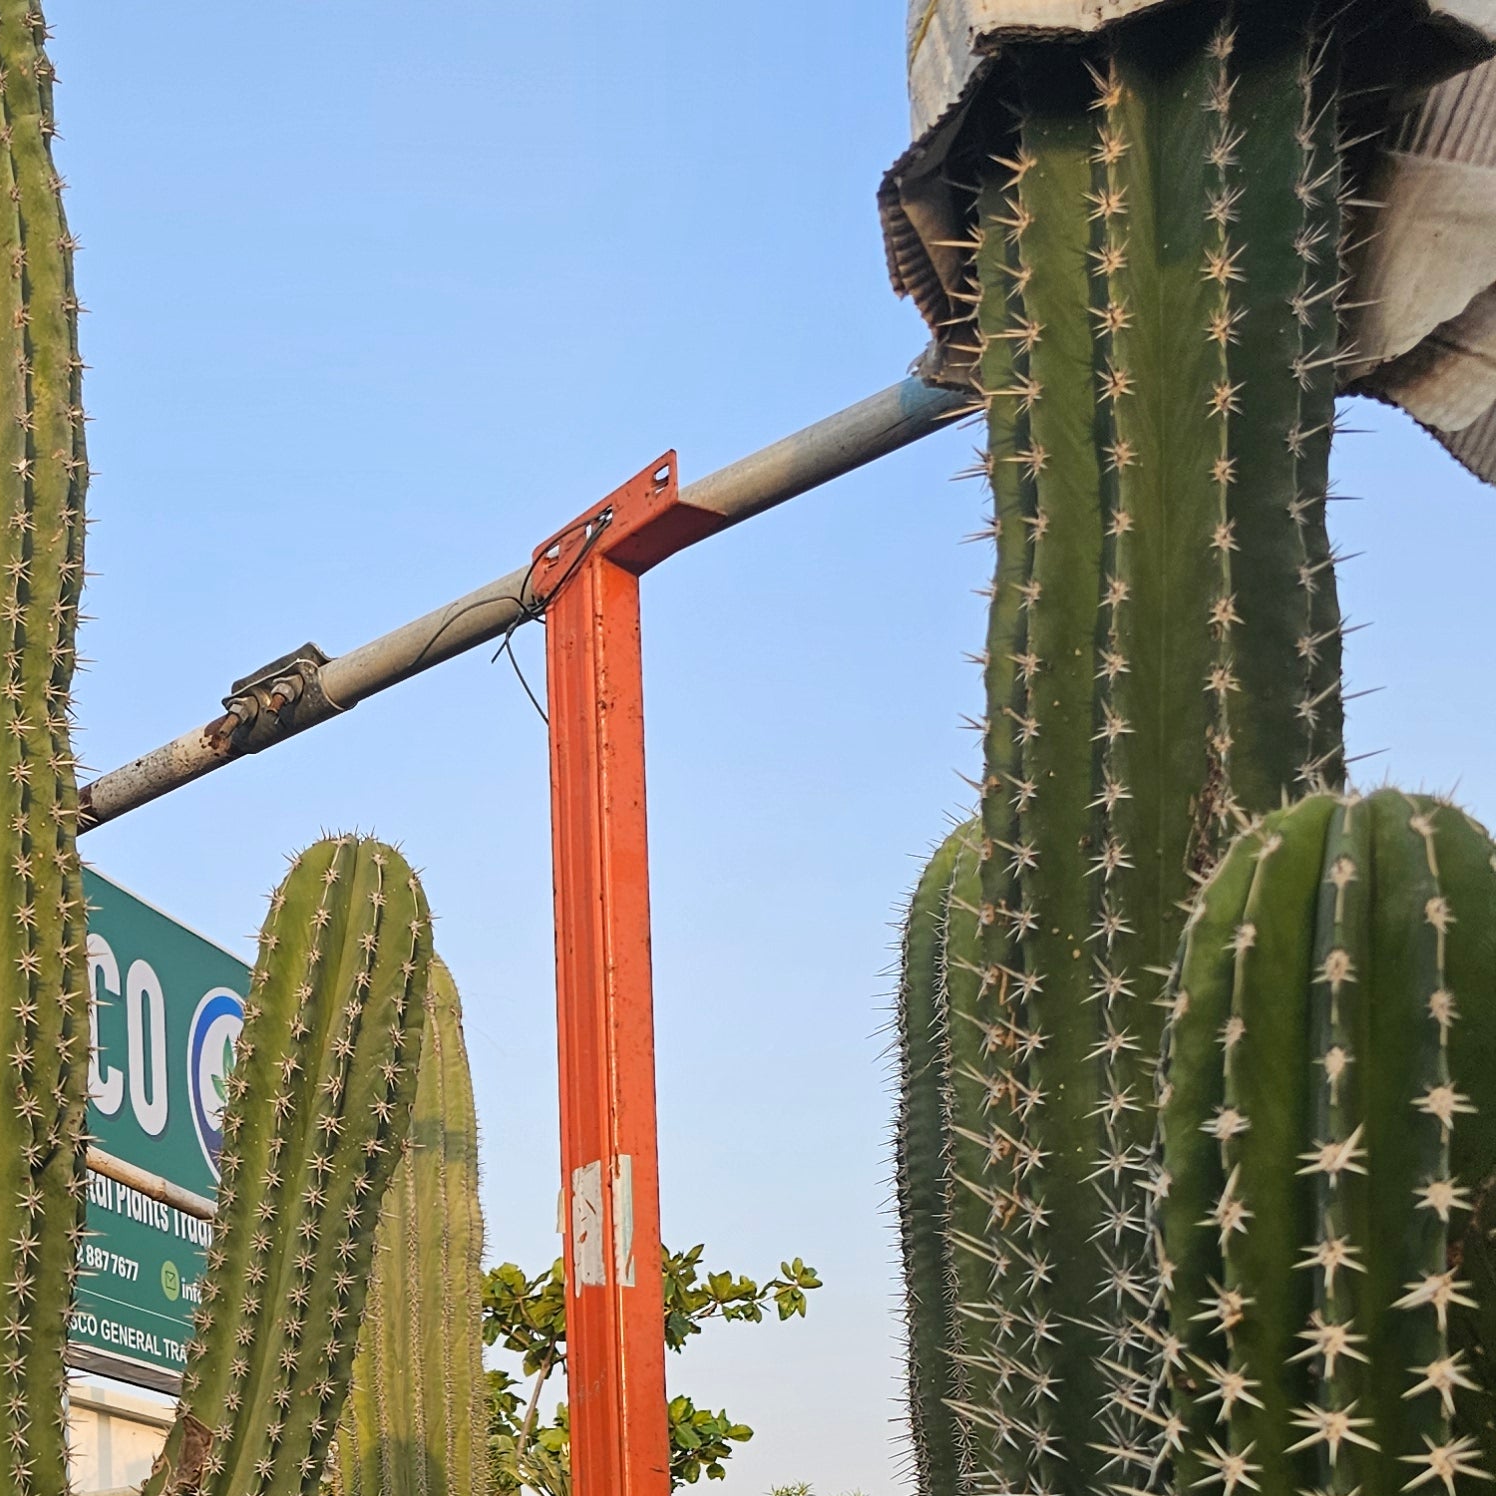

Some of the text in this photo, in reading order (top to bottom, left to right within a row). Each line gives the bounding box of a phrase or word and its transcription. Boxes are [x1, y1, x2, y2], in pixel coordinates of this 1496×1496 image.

[86, 1169, 112, 1210] tal
[116, 1181, 168, 1232] Plants
[86, 1244, 109, 1271] 887
[111, 1254, 139, 1281] 7677
[101, 1319, 161, 1356] GENERAL
